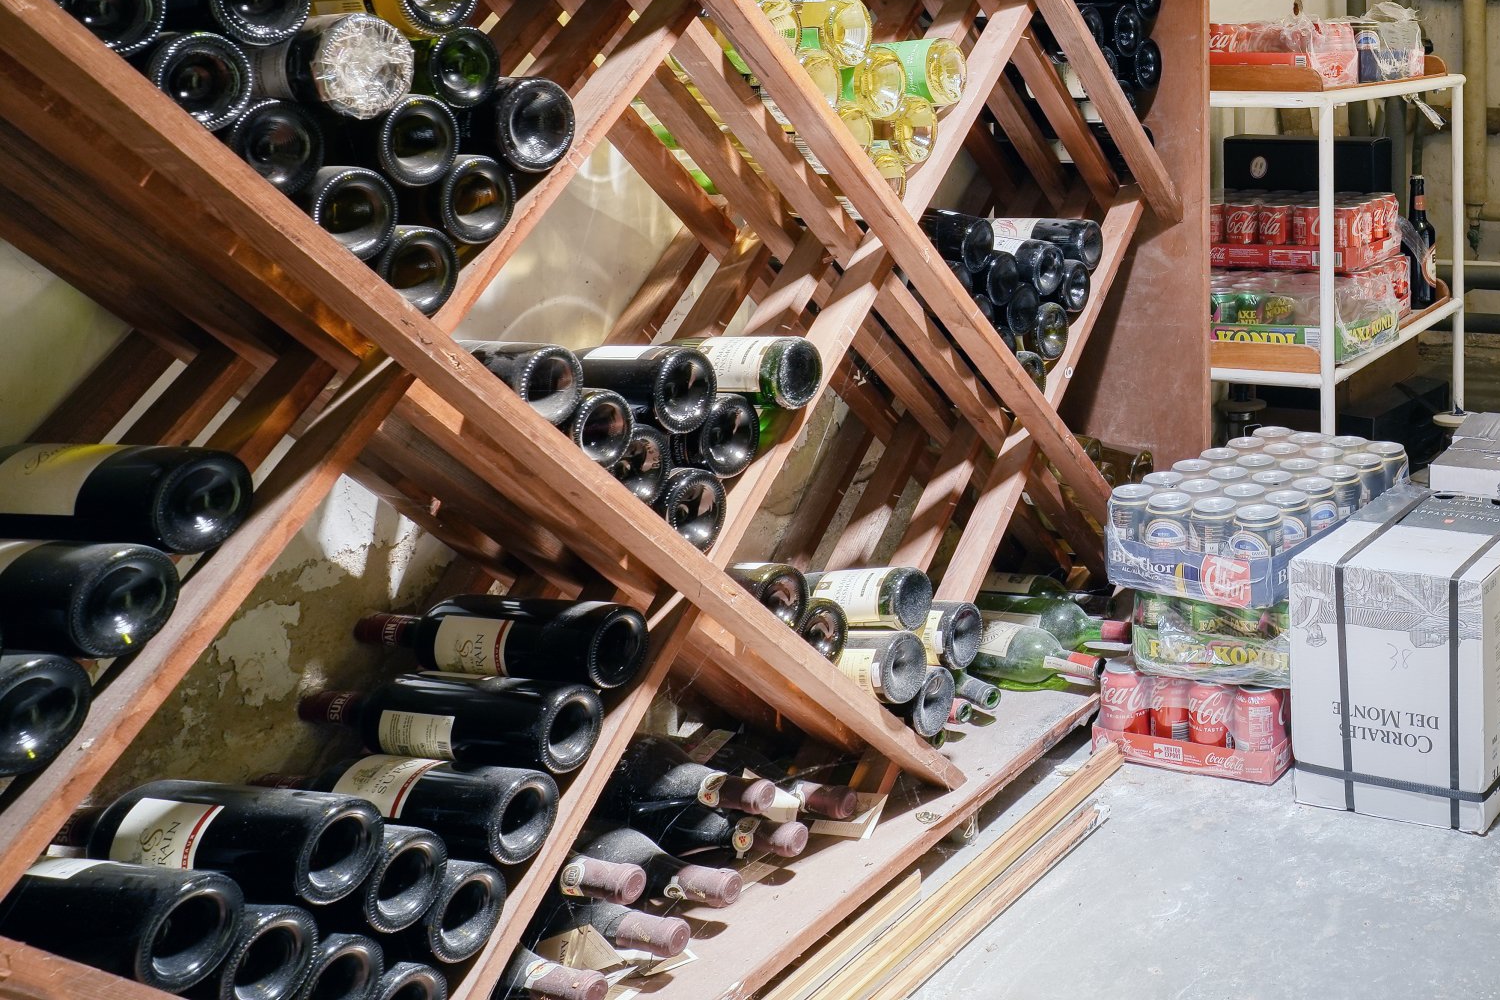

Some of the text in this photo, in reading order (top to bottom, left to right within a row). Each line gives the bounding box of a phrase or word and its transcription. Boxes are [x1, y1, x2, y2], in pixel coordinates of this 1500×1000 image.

[1259, 210, 1284, 236] ola
[1411, 509, 1500, 523] APPASSIMENTO
[1213, 645, 1290, 670] KONDI
[1331, 701, 1440, 730] DEL MONE
[1164, 752, 1181, 760] EXPORT
[1204, 752, 1244, 771] Coca-Cola
[157, 820, 182, 866] RAIN
[182, 833, 195, 867] DEAUX
